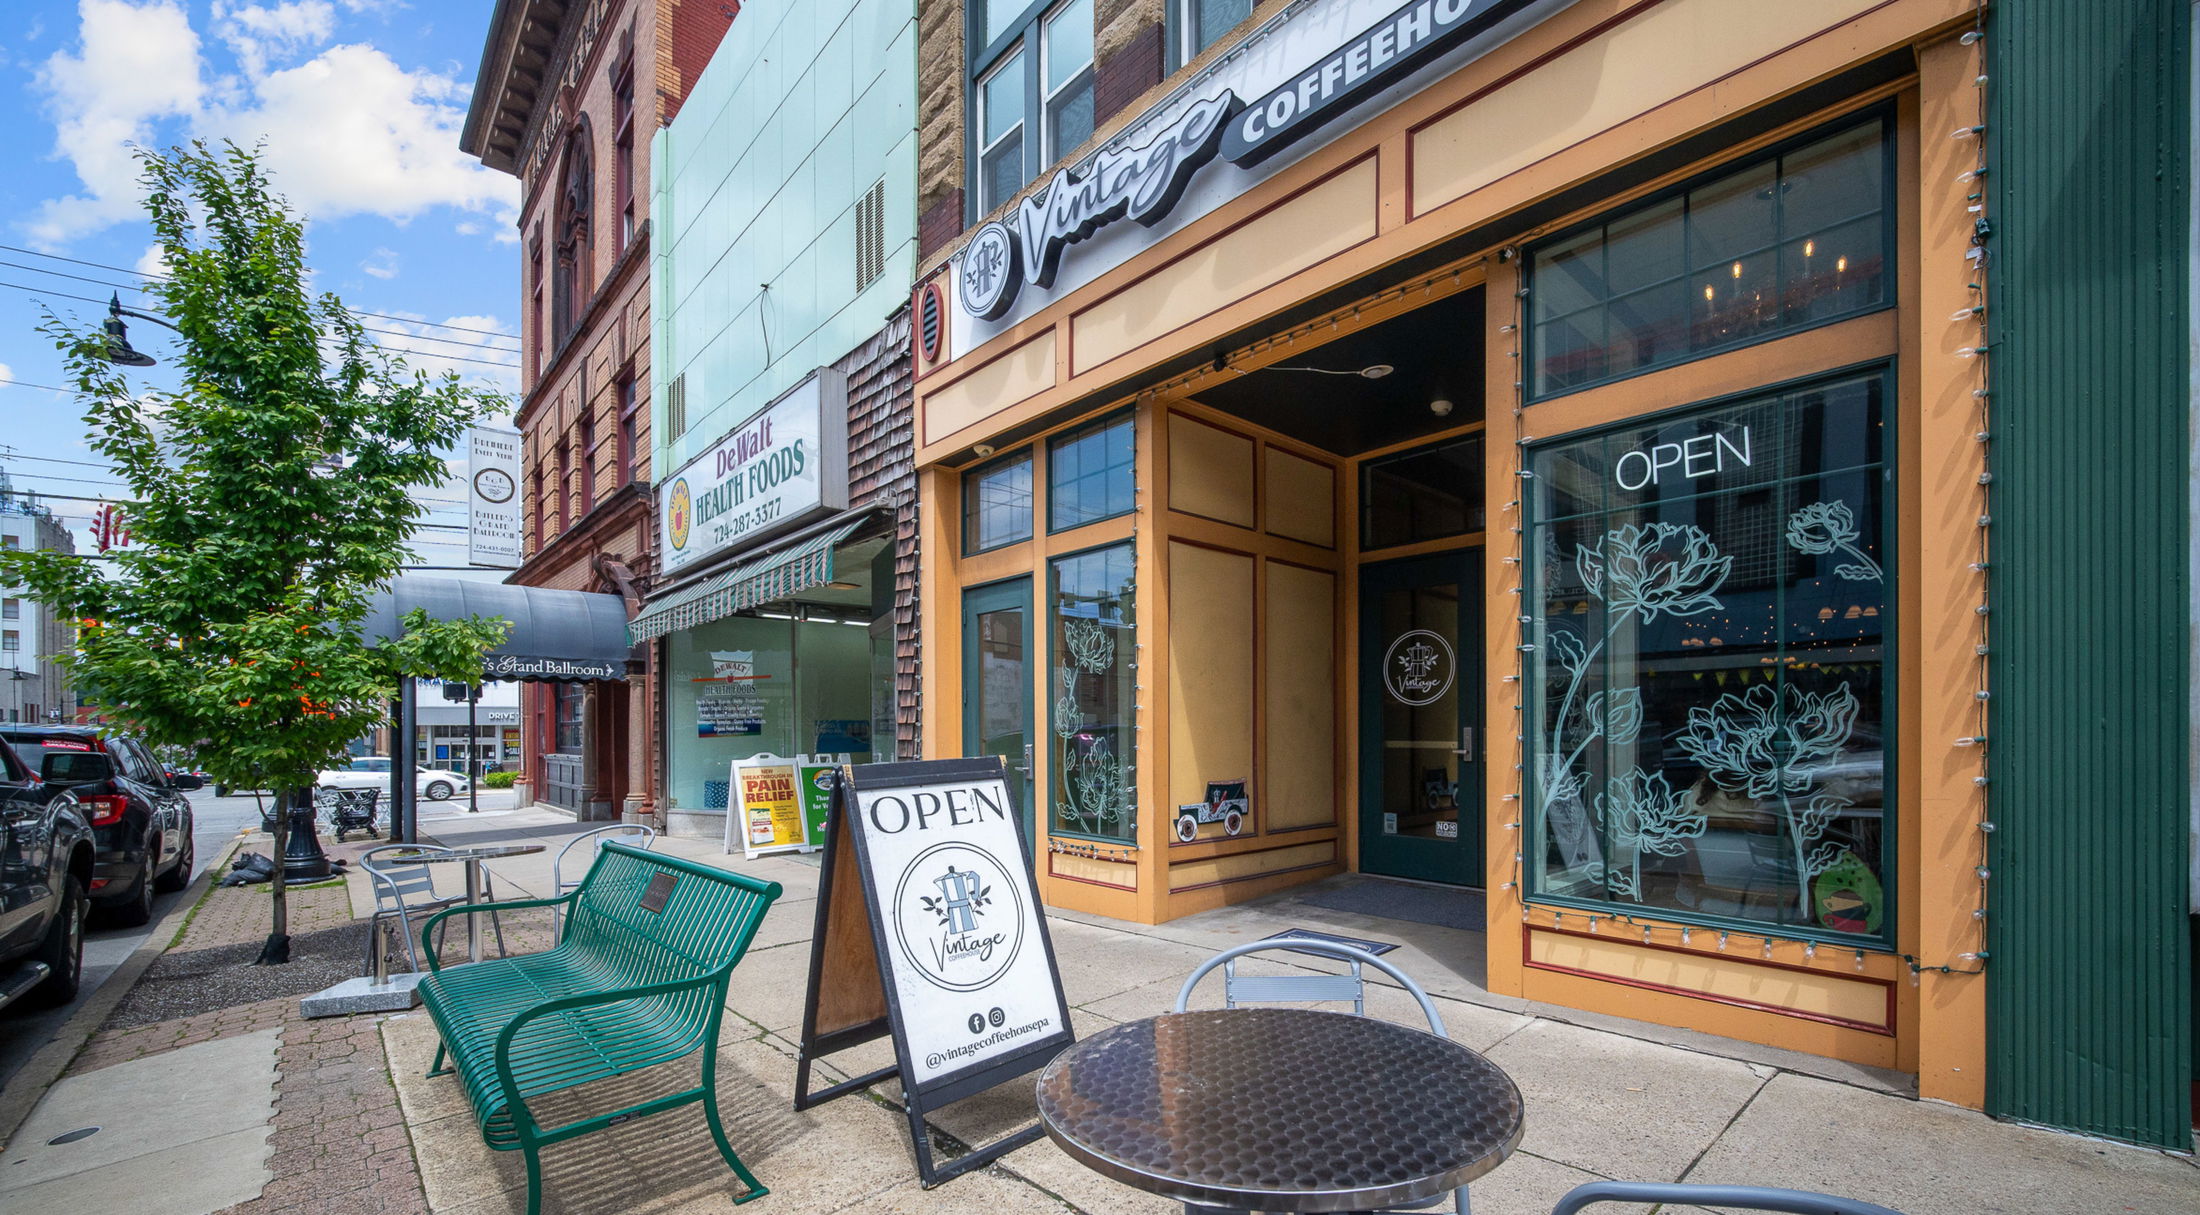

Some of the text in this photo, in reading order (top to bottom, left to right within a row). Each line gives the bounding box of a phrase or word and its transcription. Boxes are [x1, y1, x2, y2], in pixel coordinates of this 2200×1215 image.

[1026, 99, 1228, 270] Vintage
[716, 415, 773, 479] DeWalt
[1616, 426, 1751, 490] OPEN
[696, 438, 805, 526] HEALTH FOODS
[714, 496, 782, 545] 724-287-3377
[497, 655, 544, 673] Grand
[546, 660, 604, 676] Ballroom
[714, 663, 746, 675] DEWALT
[705, 683, 757, 696] HEALTH FOODS
[1398, 673, 1441, 694] Vintage
[488, 712, 515, 720] DRIVE
[742, 773, 785, 781] BREAKTHROUGH
[746, 778, 791, 793] PAIN
[745, 791, 794, 803] RELIEF
[870, 785, 1005, 834] OPEN
[929, 930, 1007, 973] Vintage
[948, 949, 981, 963] COFFEEHOUSE
[926, 1018, 1050, 1070] @vintagecoffeehousepa
